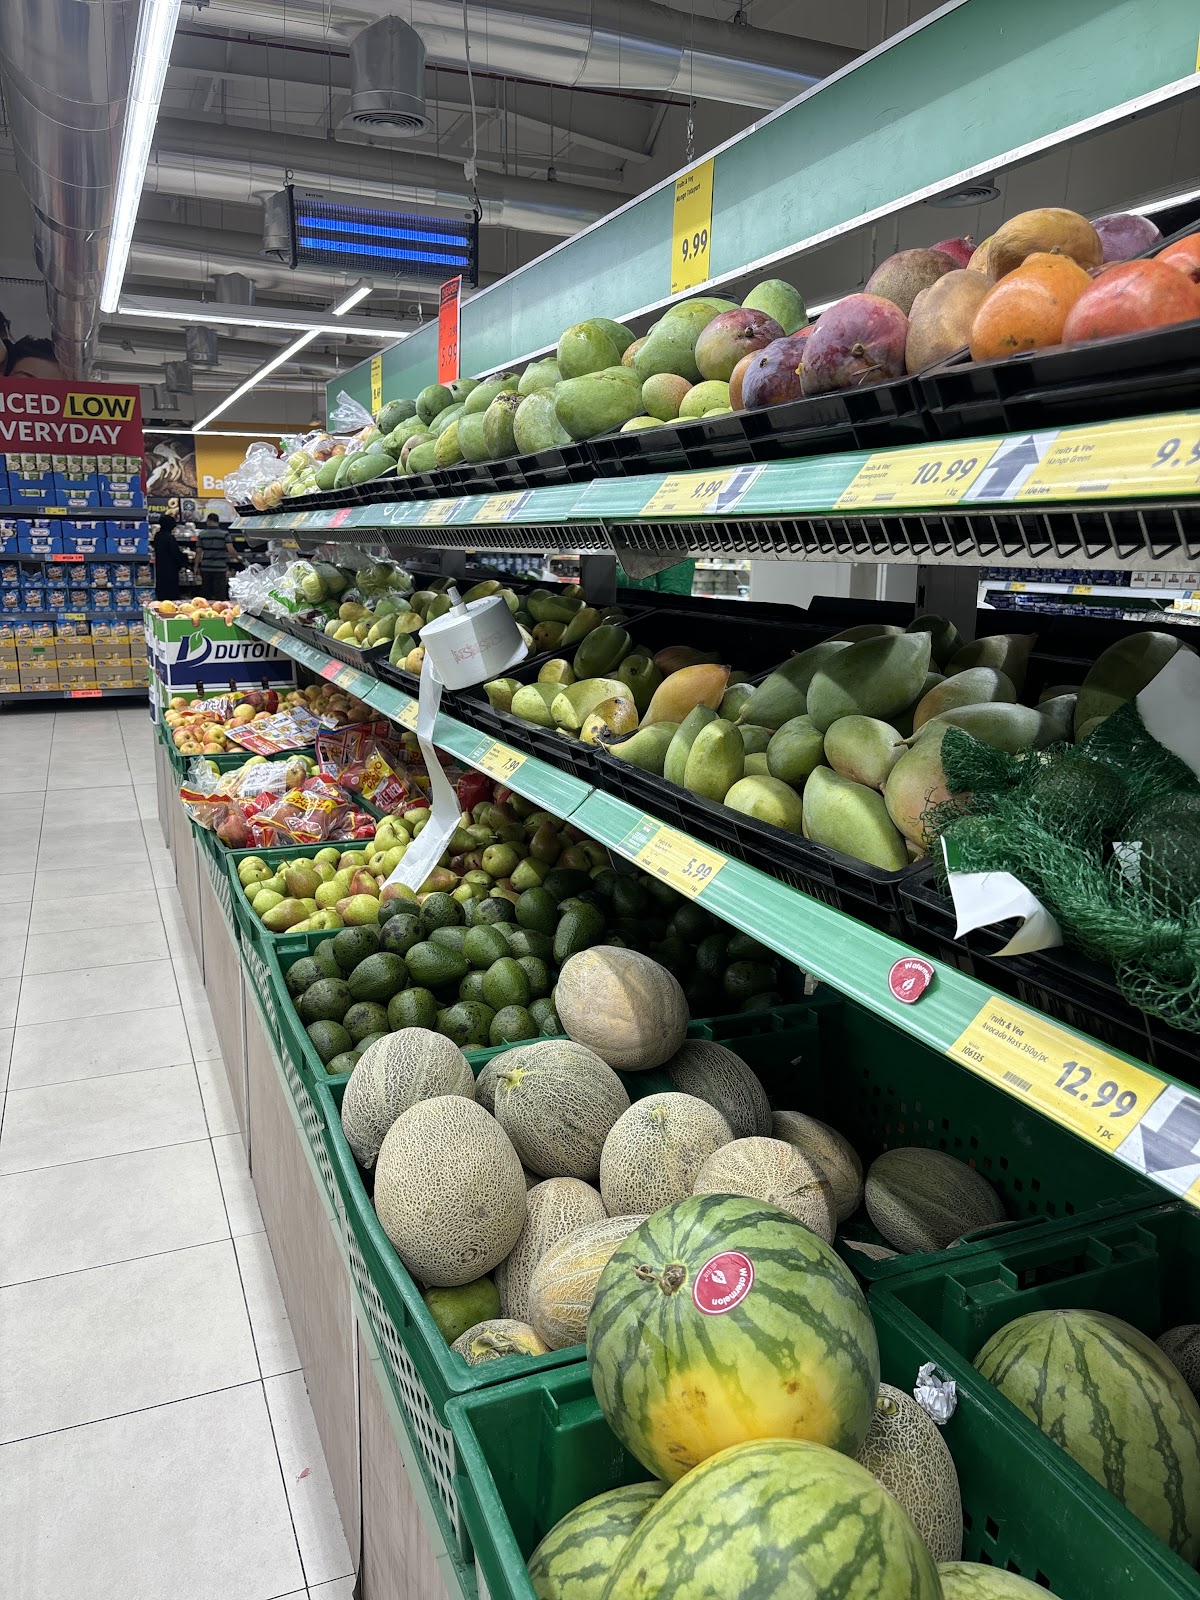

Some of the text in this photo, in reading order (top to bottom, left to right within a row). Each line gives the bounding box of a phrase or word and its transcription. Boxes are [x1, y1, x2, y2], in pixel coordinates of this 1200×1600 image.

[682, 229, 708, 262] 9.99
[69, 395, 131, 419] LOW
[911, 457, 978, 485] 10.99
[1069, 454, 1091, 463] Green
[691, 480, 724, 498] 9.99
[682, 857, 713, 882] 5.99
[981, 1021, 1009, 1042] Avocado
[1007, 1035, 1023, 1050] Hass
[961, 1045, 985, 1063] 106135
[1054, 1060, 1138, 1118] 12.99
[1101, 1127, 1115, 1141] pc
[711, 1267, 748, 1306] Watermelon
